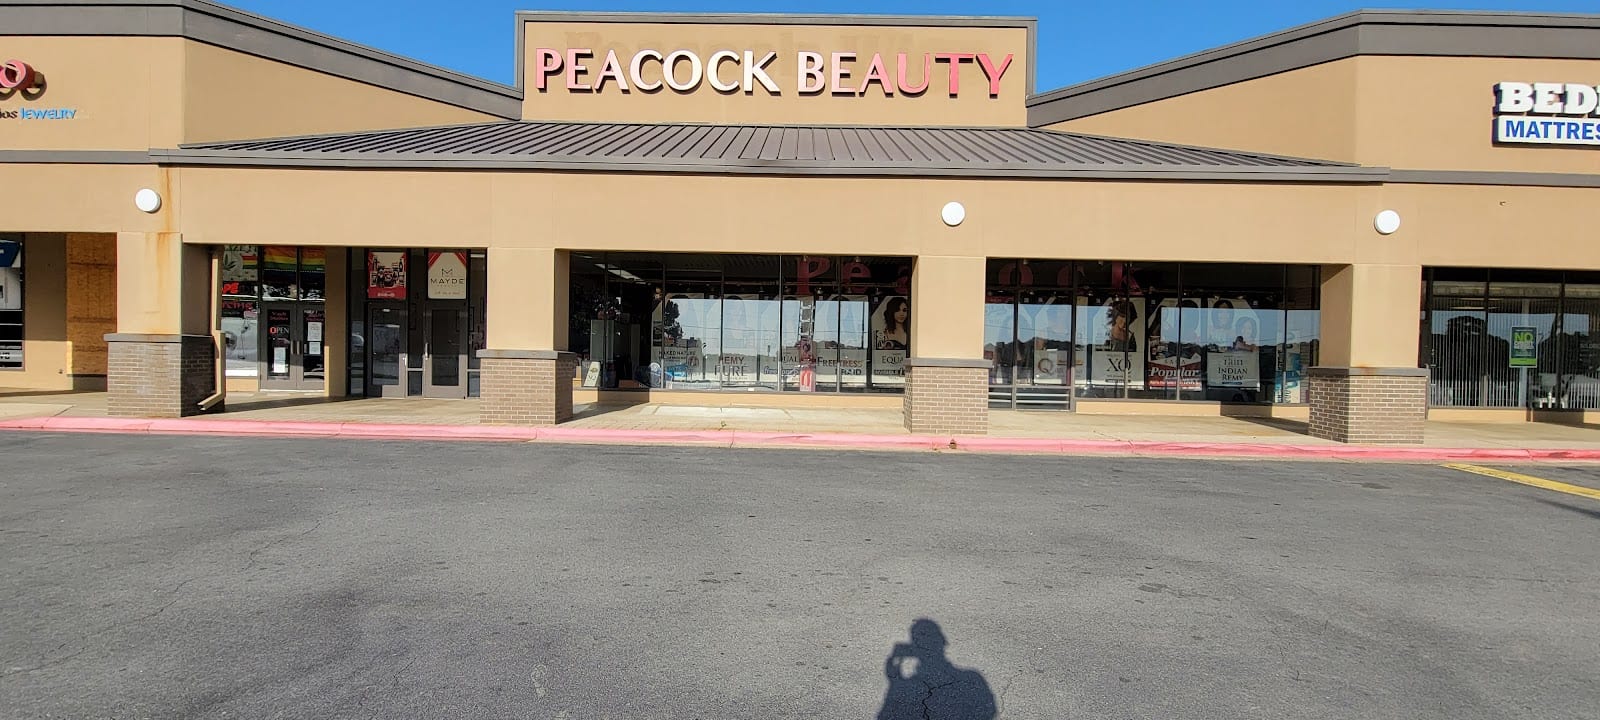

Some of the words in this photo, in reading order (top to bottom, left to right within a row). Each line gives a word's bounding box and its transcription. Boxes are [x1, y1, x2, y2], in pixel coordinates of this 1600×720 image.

[535, 48, 779, 94] PEACOCK
[797, 51, 1014, 96] BEAUTY
[1498, 82, 1600, 115] BED
[269, 326, 289, 335] OPEN
[1514, 332, 1534, 342] NO
[1218, 367, 1248, 375] INDIAN
